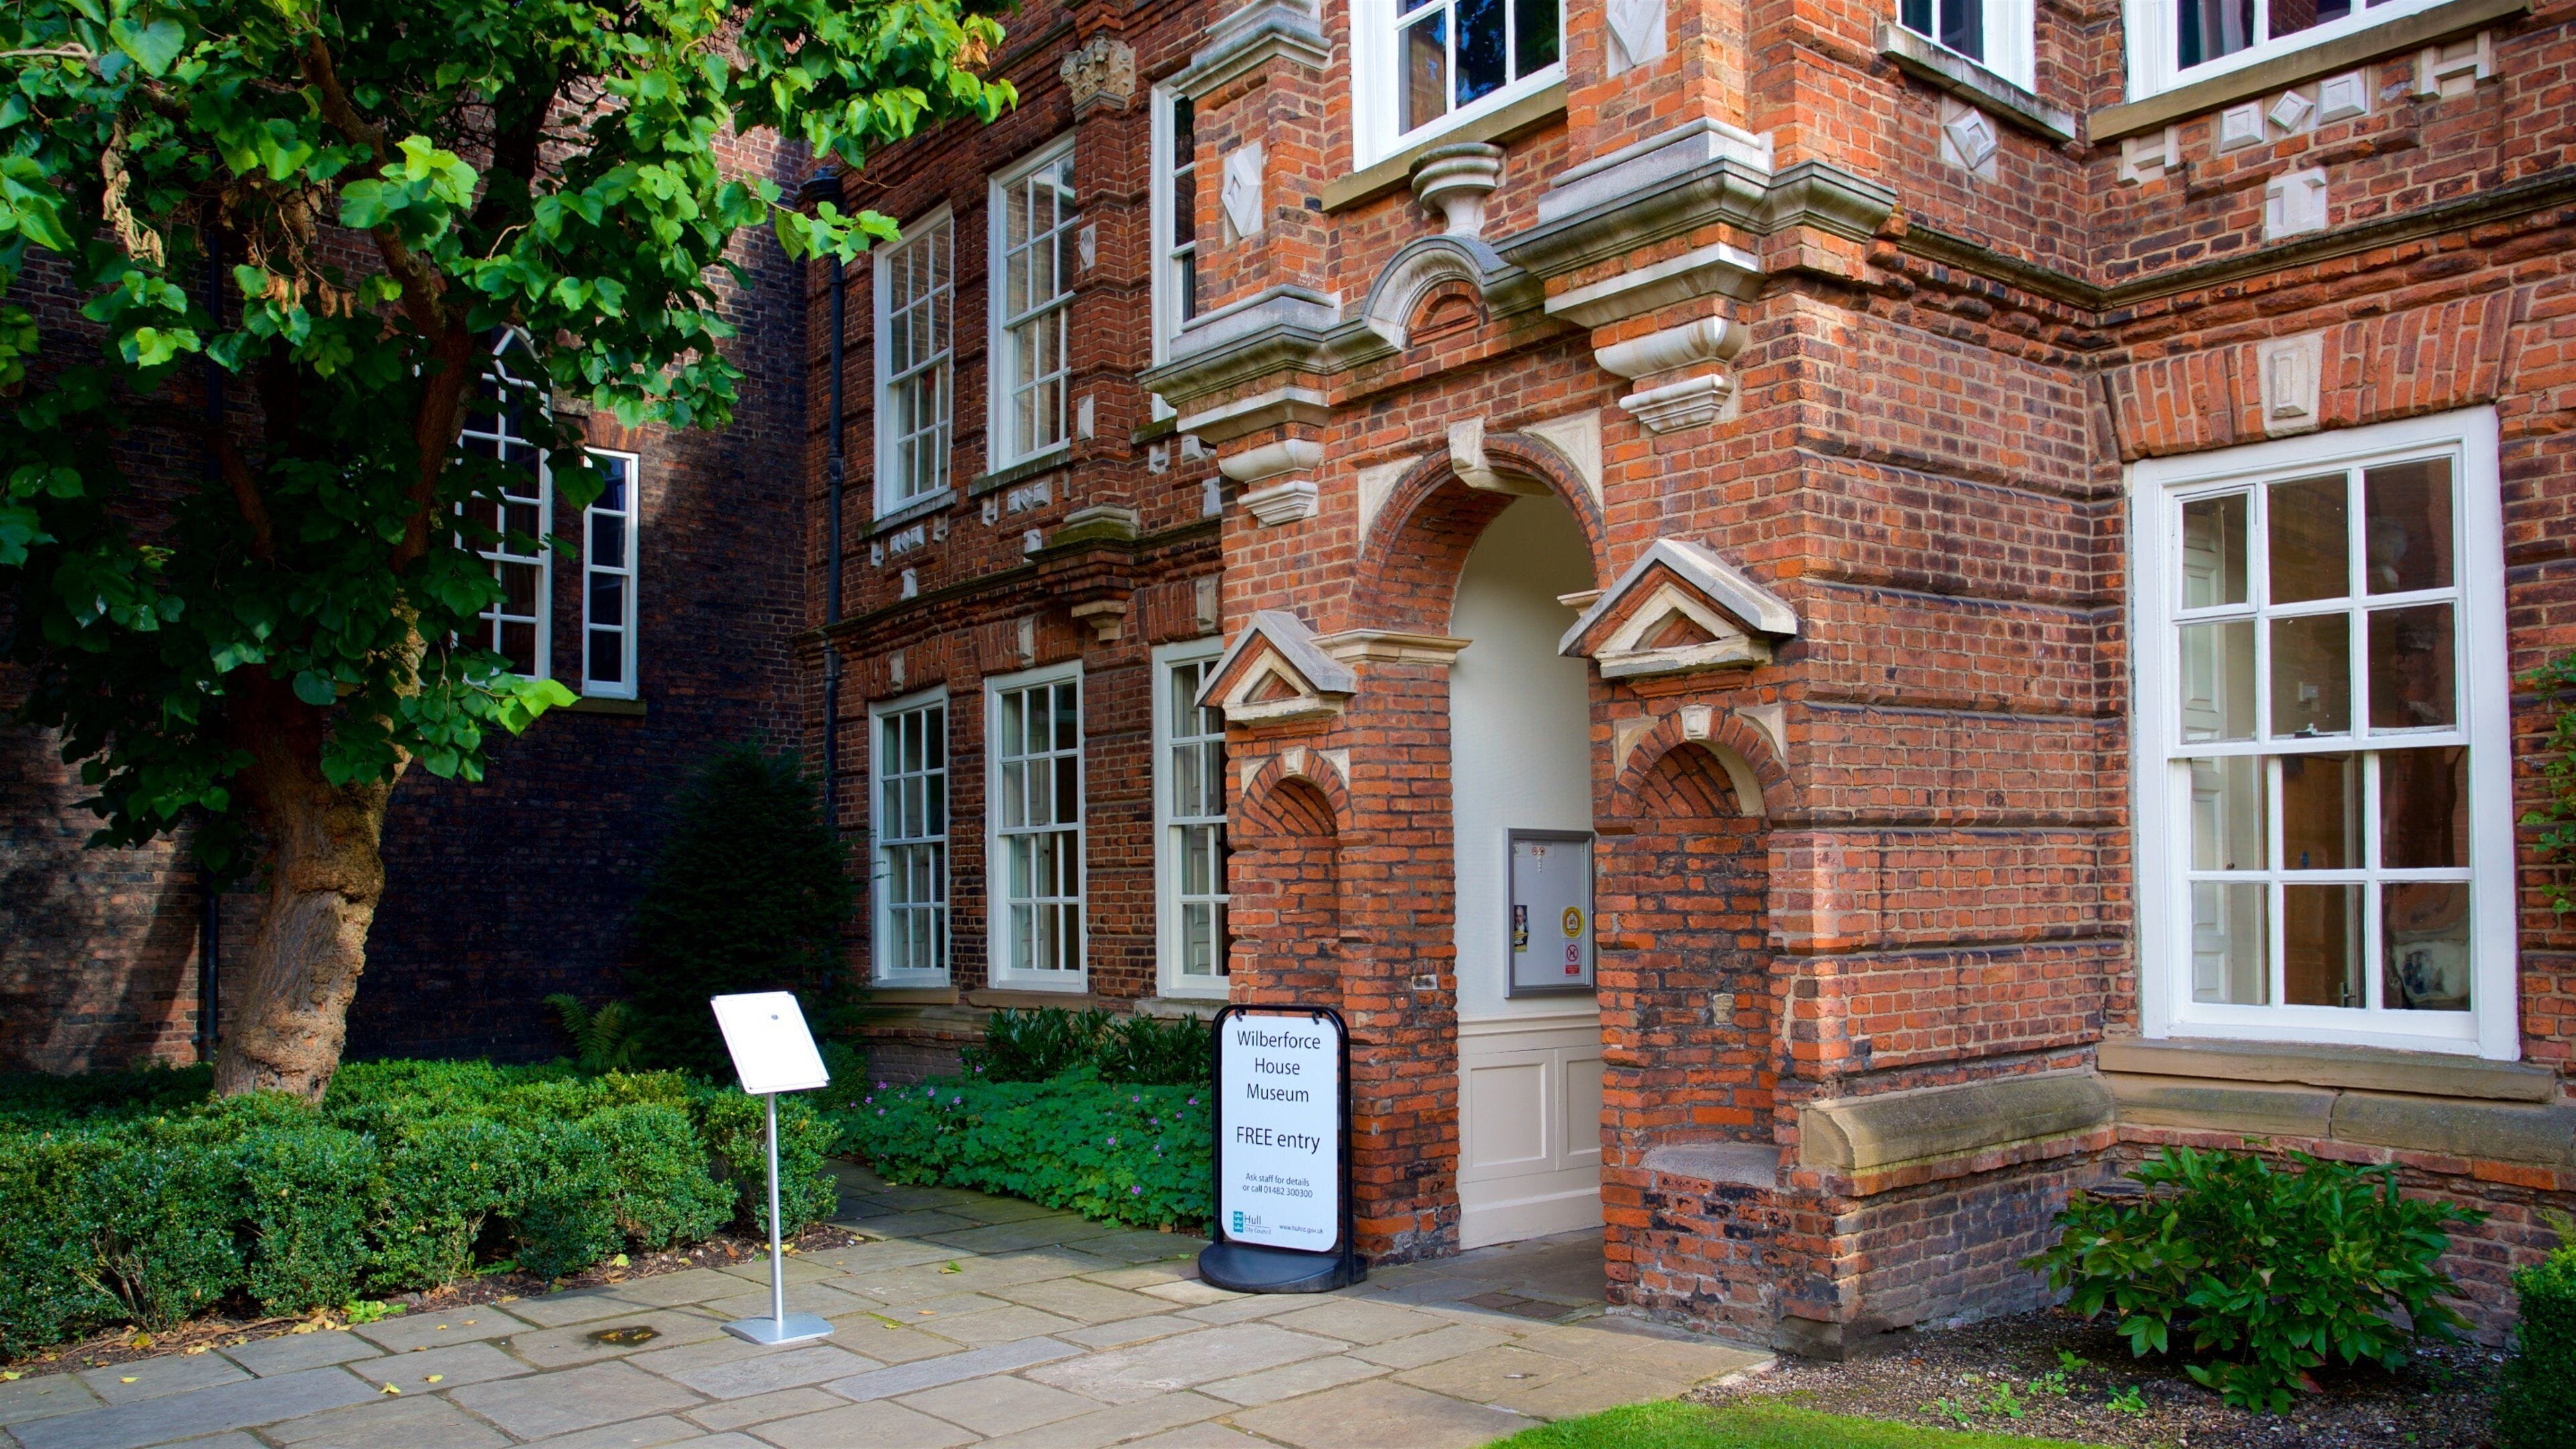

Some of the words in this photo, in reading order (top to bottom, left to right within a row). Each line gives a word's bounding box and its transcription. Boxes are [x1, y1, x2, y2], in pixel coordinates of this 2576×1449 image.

[1237, 1030, 1321, 1049] Wilberforce
[1255, 1057, 1300, 1075] House
[1246, 1083, 1309, 1103] Museum
[1237, 1126, 1273, 1146] FREE
[1277, 1133, 1320, 1155] entry
[1246, 1173, 1258, 1181] Ask
[1258, 1175, 1274, 1183] staff
[1275, 1175, 1285, 1184] for
[1286, 1177, 1309, 1187] details
[1251, 1185, 1263, 1193] call
[1264, 1186, 1285, 1195] 01482
[1287, 1188, 1313, 1198] 300300
[1244, 1215, 1262, 1225] Hull
